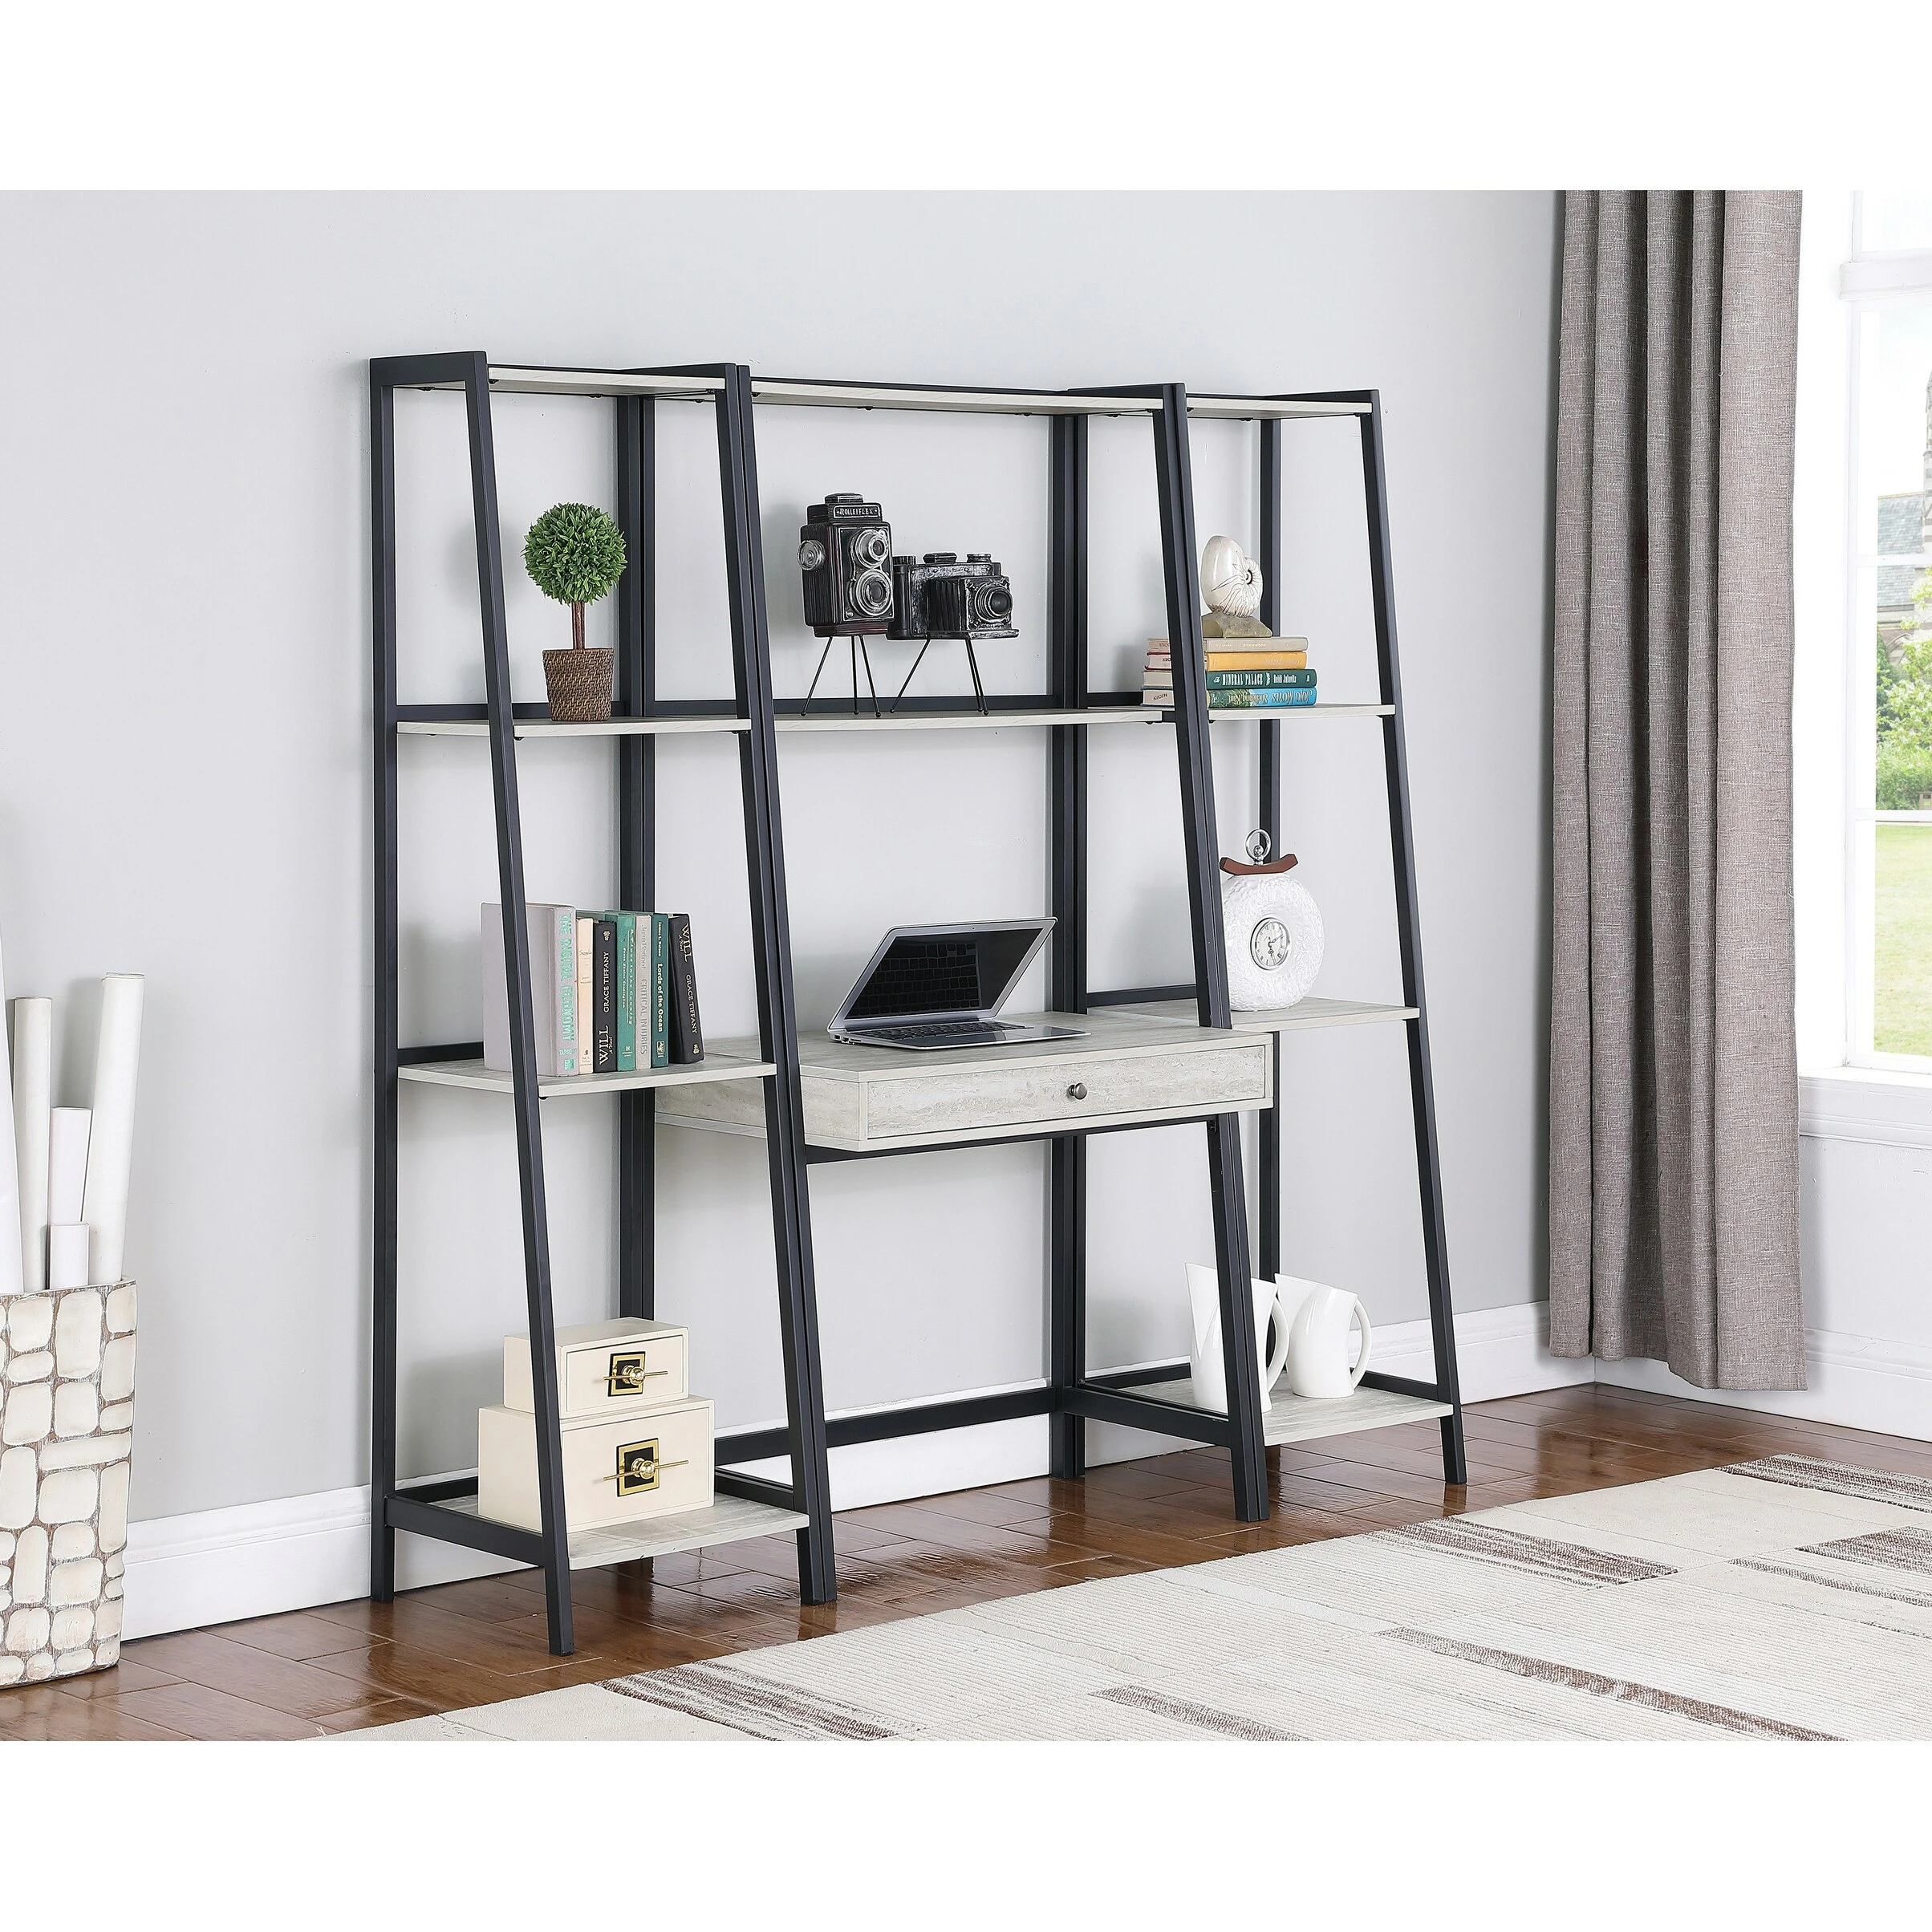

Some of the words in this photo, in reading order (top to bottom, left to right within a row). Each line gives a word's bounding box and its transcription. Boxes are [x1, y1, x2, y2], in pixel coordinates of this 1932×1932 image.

[1222, 673, 1243, 685] MINERAL
[1245, 673, 1263, 685] PALACE
[1271, 690, 1293, 704] MOYES
[560, 913, 572, 936] THE
[682, 923, 692, 963] WILL
[560, 938, 573, 983] DIGITAL
[658, 985, 664, 995] of
[685, 974, 694, 1001] GRACE
[562, 985, 574, 1041] ECONOMY
[688, 1001, 698, 1033] TIFFANY
[599, 1025, 610, 1065] WILL
[640, 1018, 648, 1055] INJURIES
